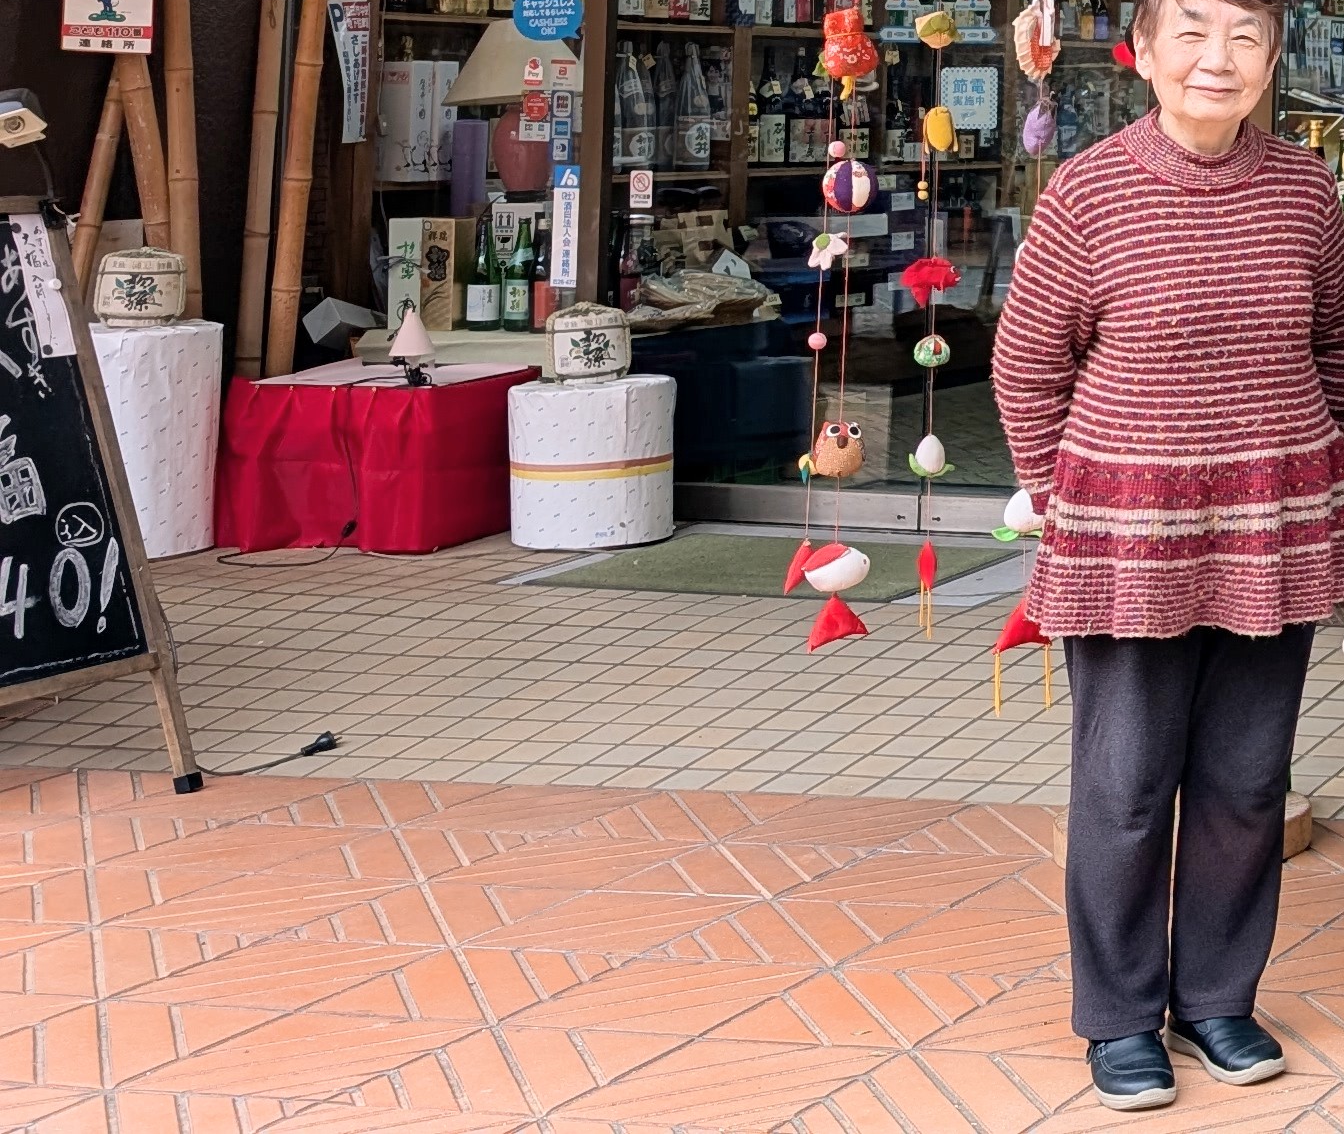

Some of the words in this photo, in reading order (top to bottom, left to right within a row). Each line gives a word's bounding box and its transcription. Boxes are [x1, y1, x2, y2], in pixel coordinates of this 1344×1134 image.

[522, 9, 576, 18] 対応してるらしいよ。
[528, 17, 568, 28] CASHLESS
[78, 38, 135, 50] 連絡所
[952, 78, 986, 95] 節電
[953, 95, 985, 107] 実施中
